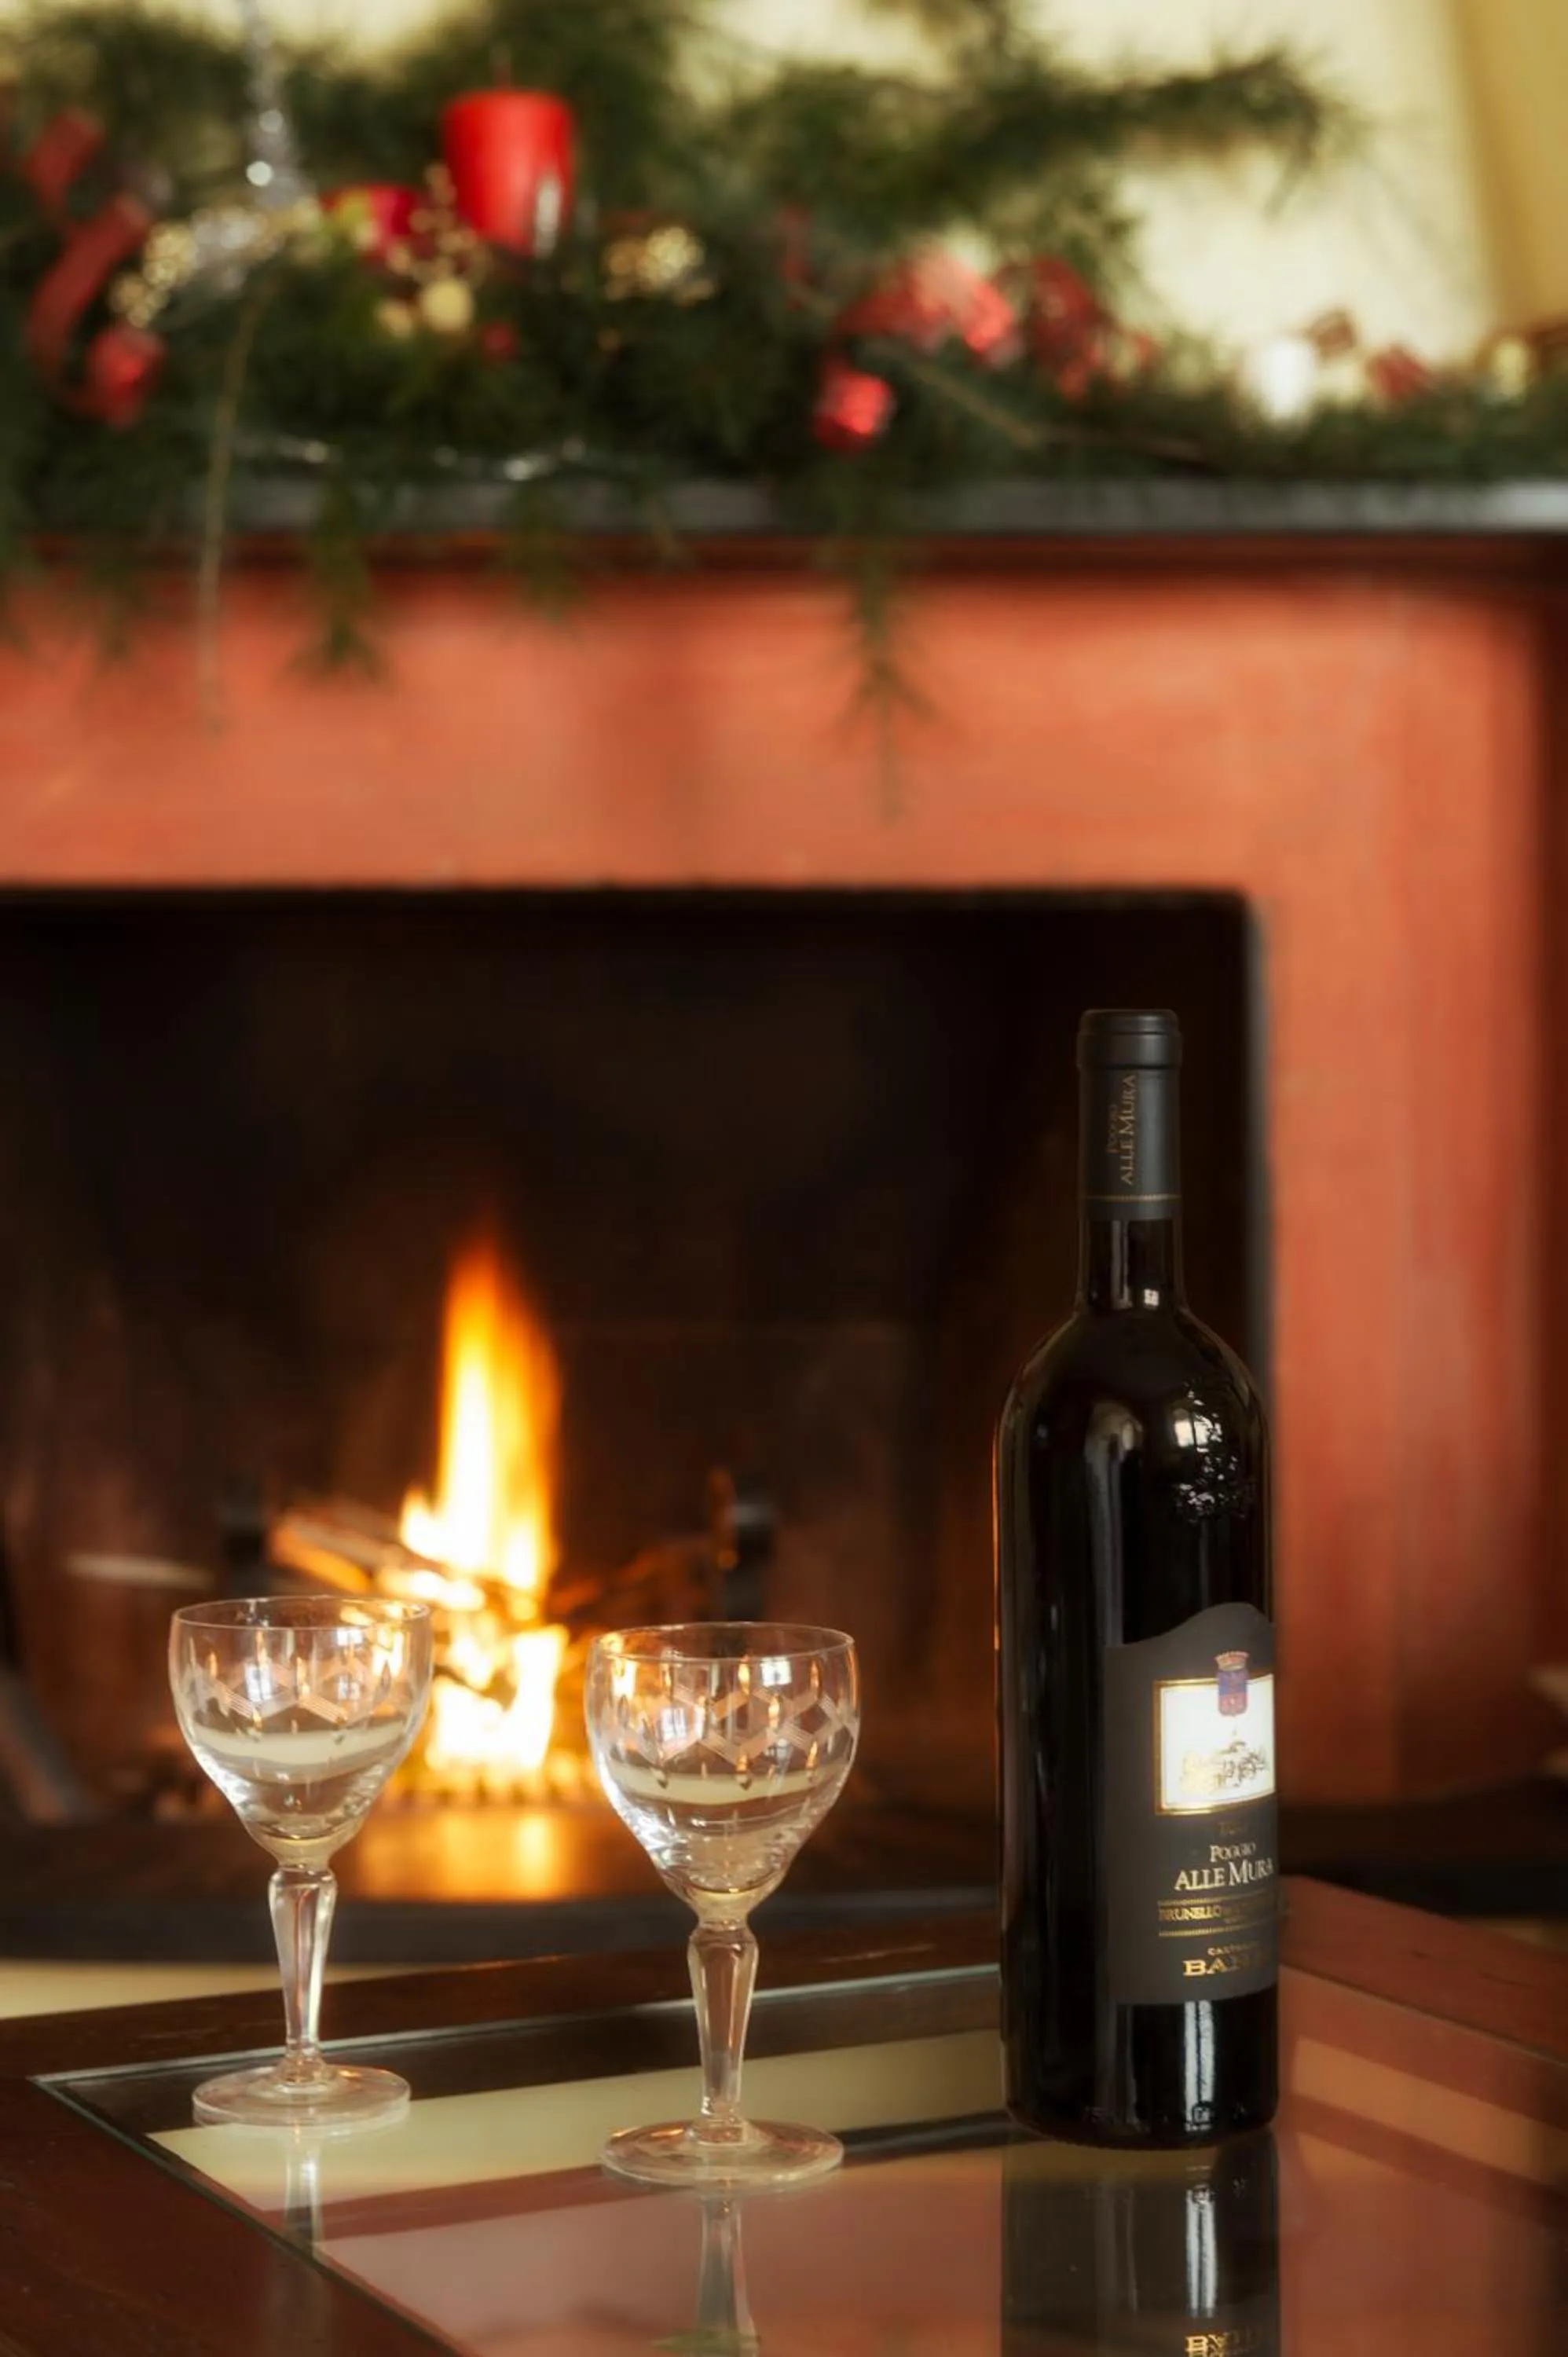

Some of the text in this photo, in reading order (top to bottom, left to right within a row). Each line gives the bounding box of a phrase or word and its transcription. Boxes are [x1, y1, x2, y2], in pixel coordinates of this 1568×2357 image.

[1118, 1074, 1138, 1186] ALLE MURA
[1174, 1857, 1274, 1891] ALLE MURA
